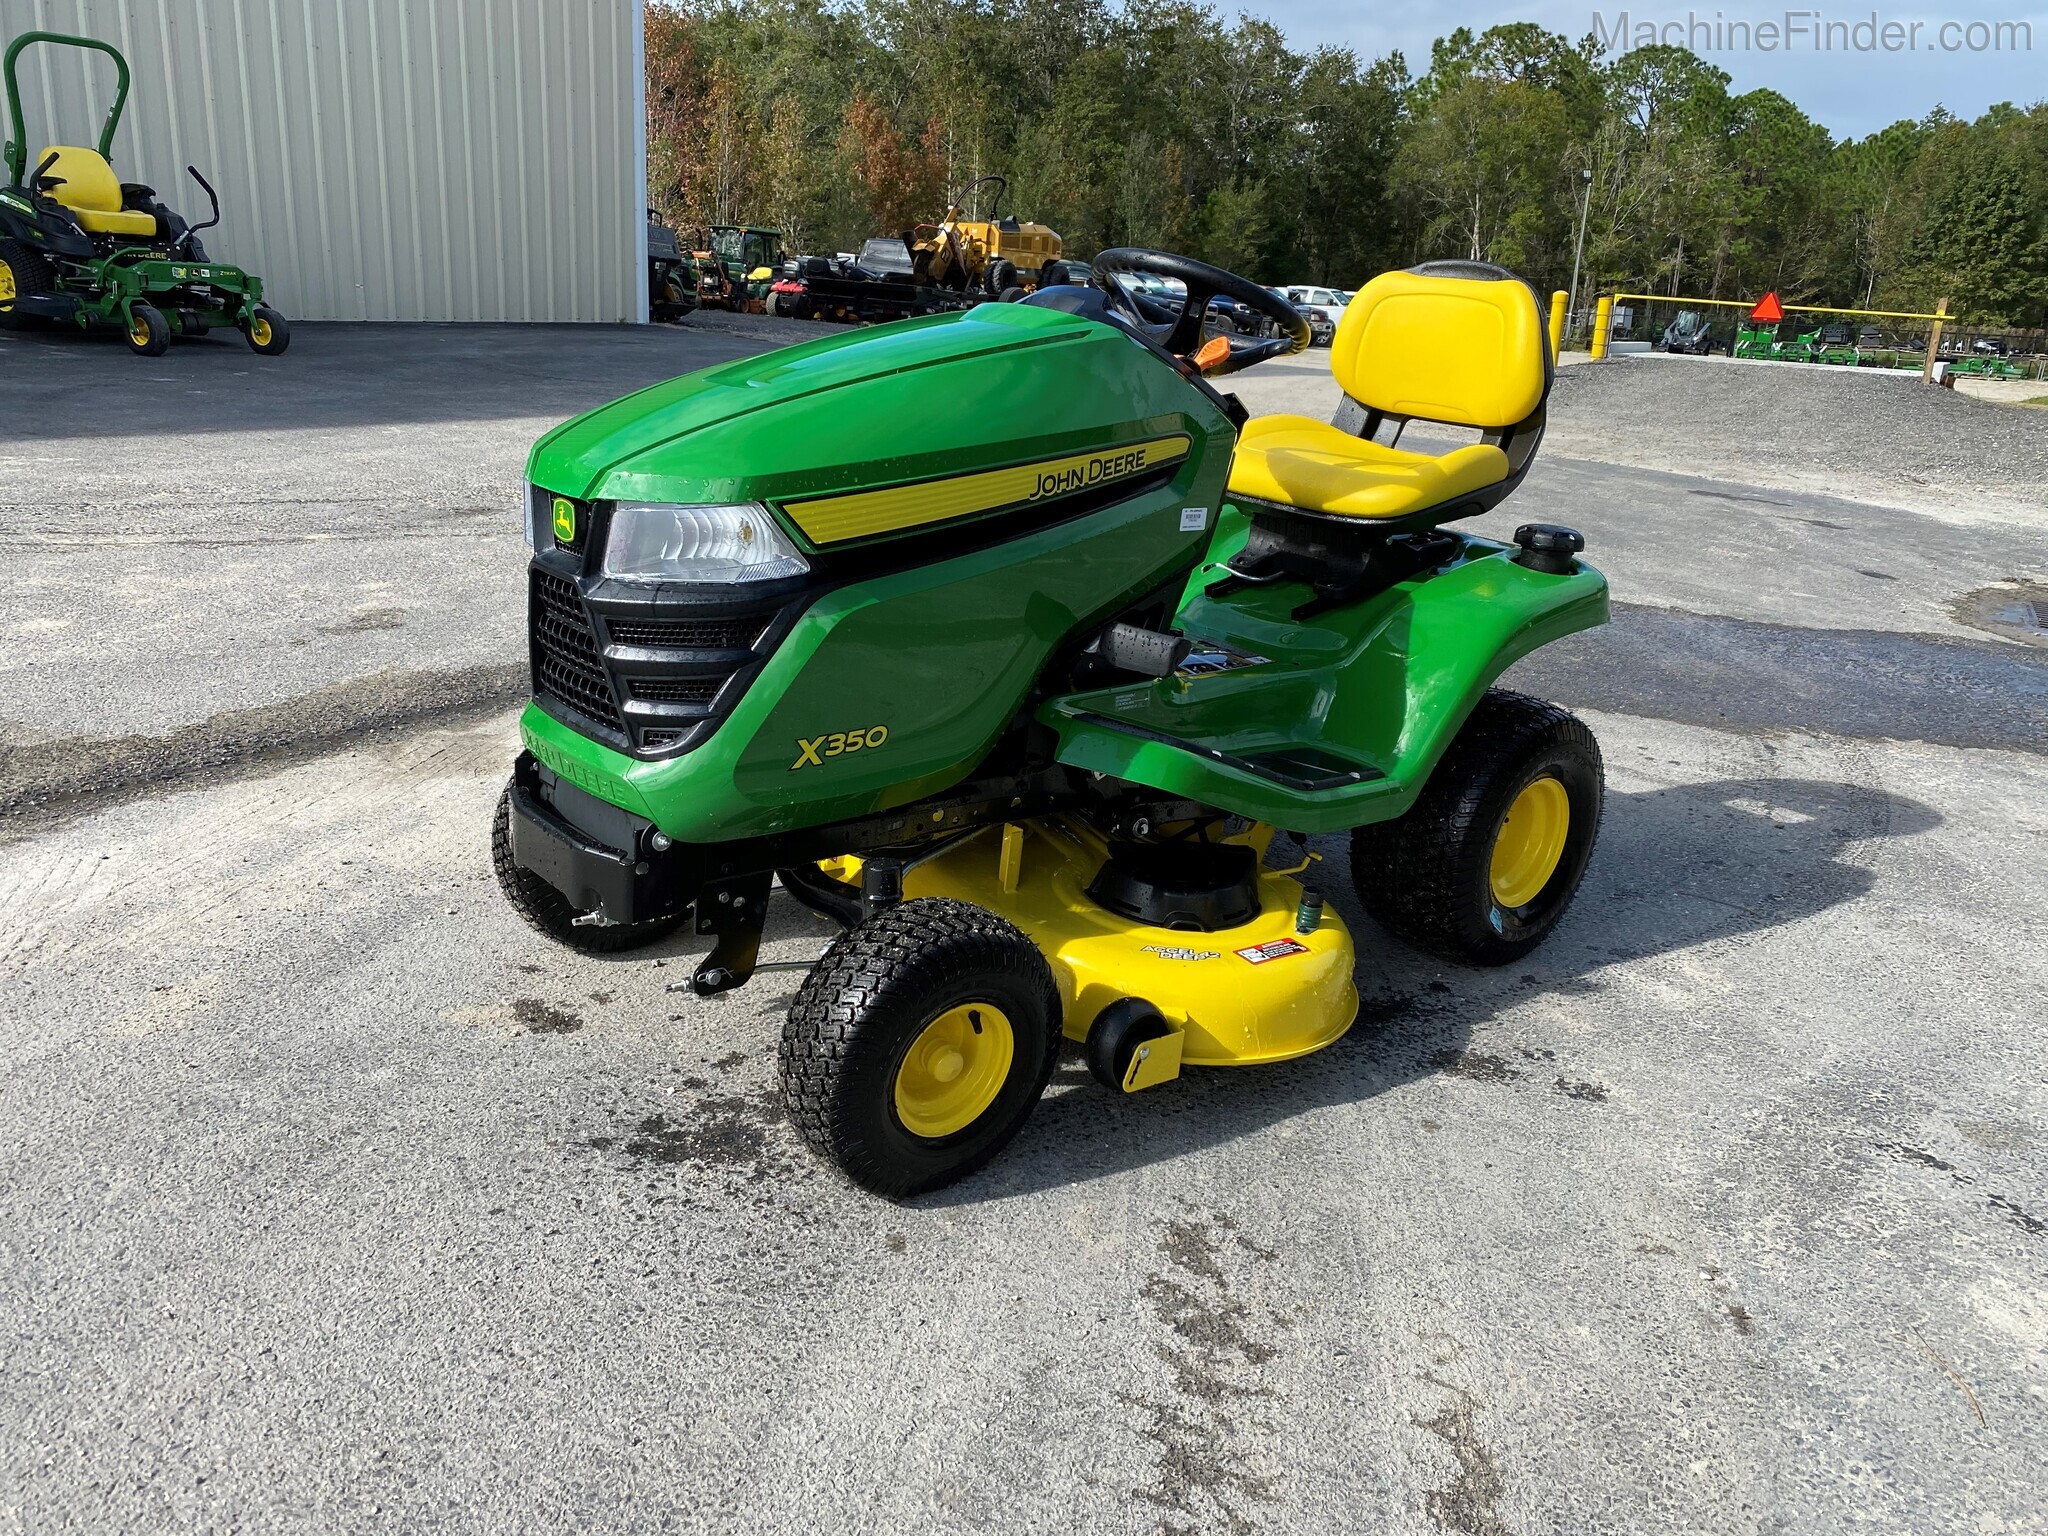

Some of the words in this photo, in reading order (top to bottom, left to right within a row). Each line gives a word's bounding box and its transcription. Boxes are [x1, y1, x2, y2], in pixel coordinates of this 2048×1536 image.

[1029, 466, 1085, 500] JOHN
[1088, 448, 1146, 484] DEERE
[788, 725, 889, 771] X350
